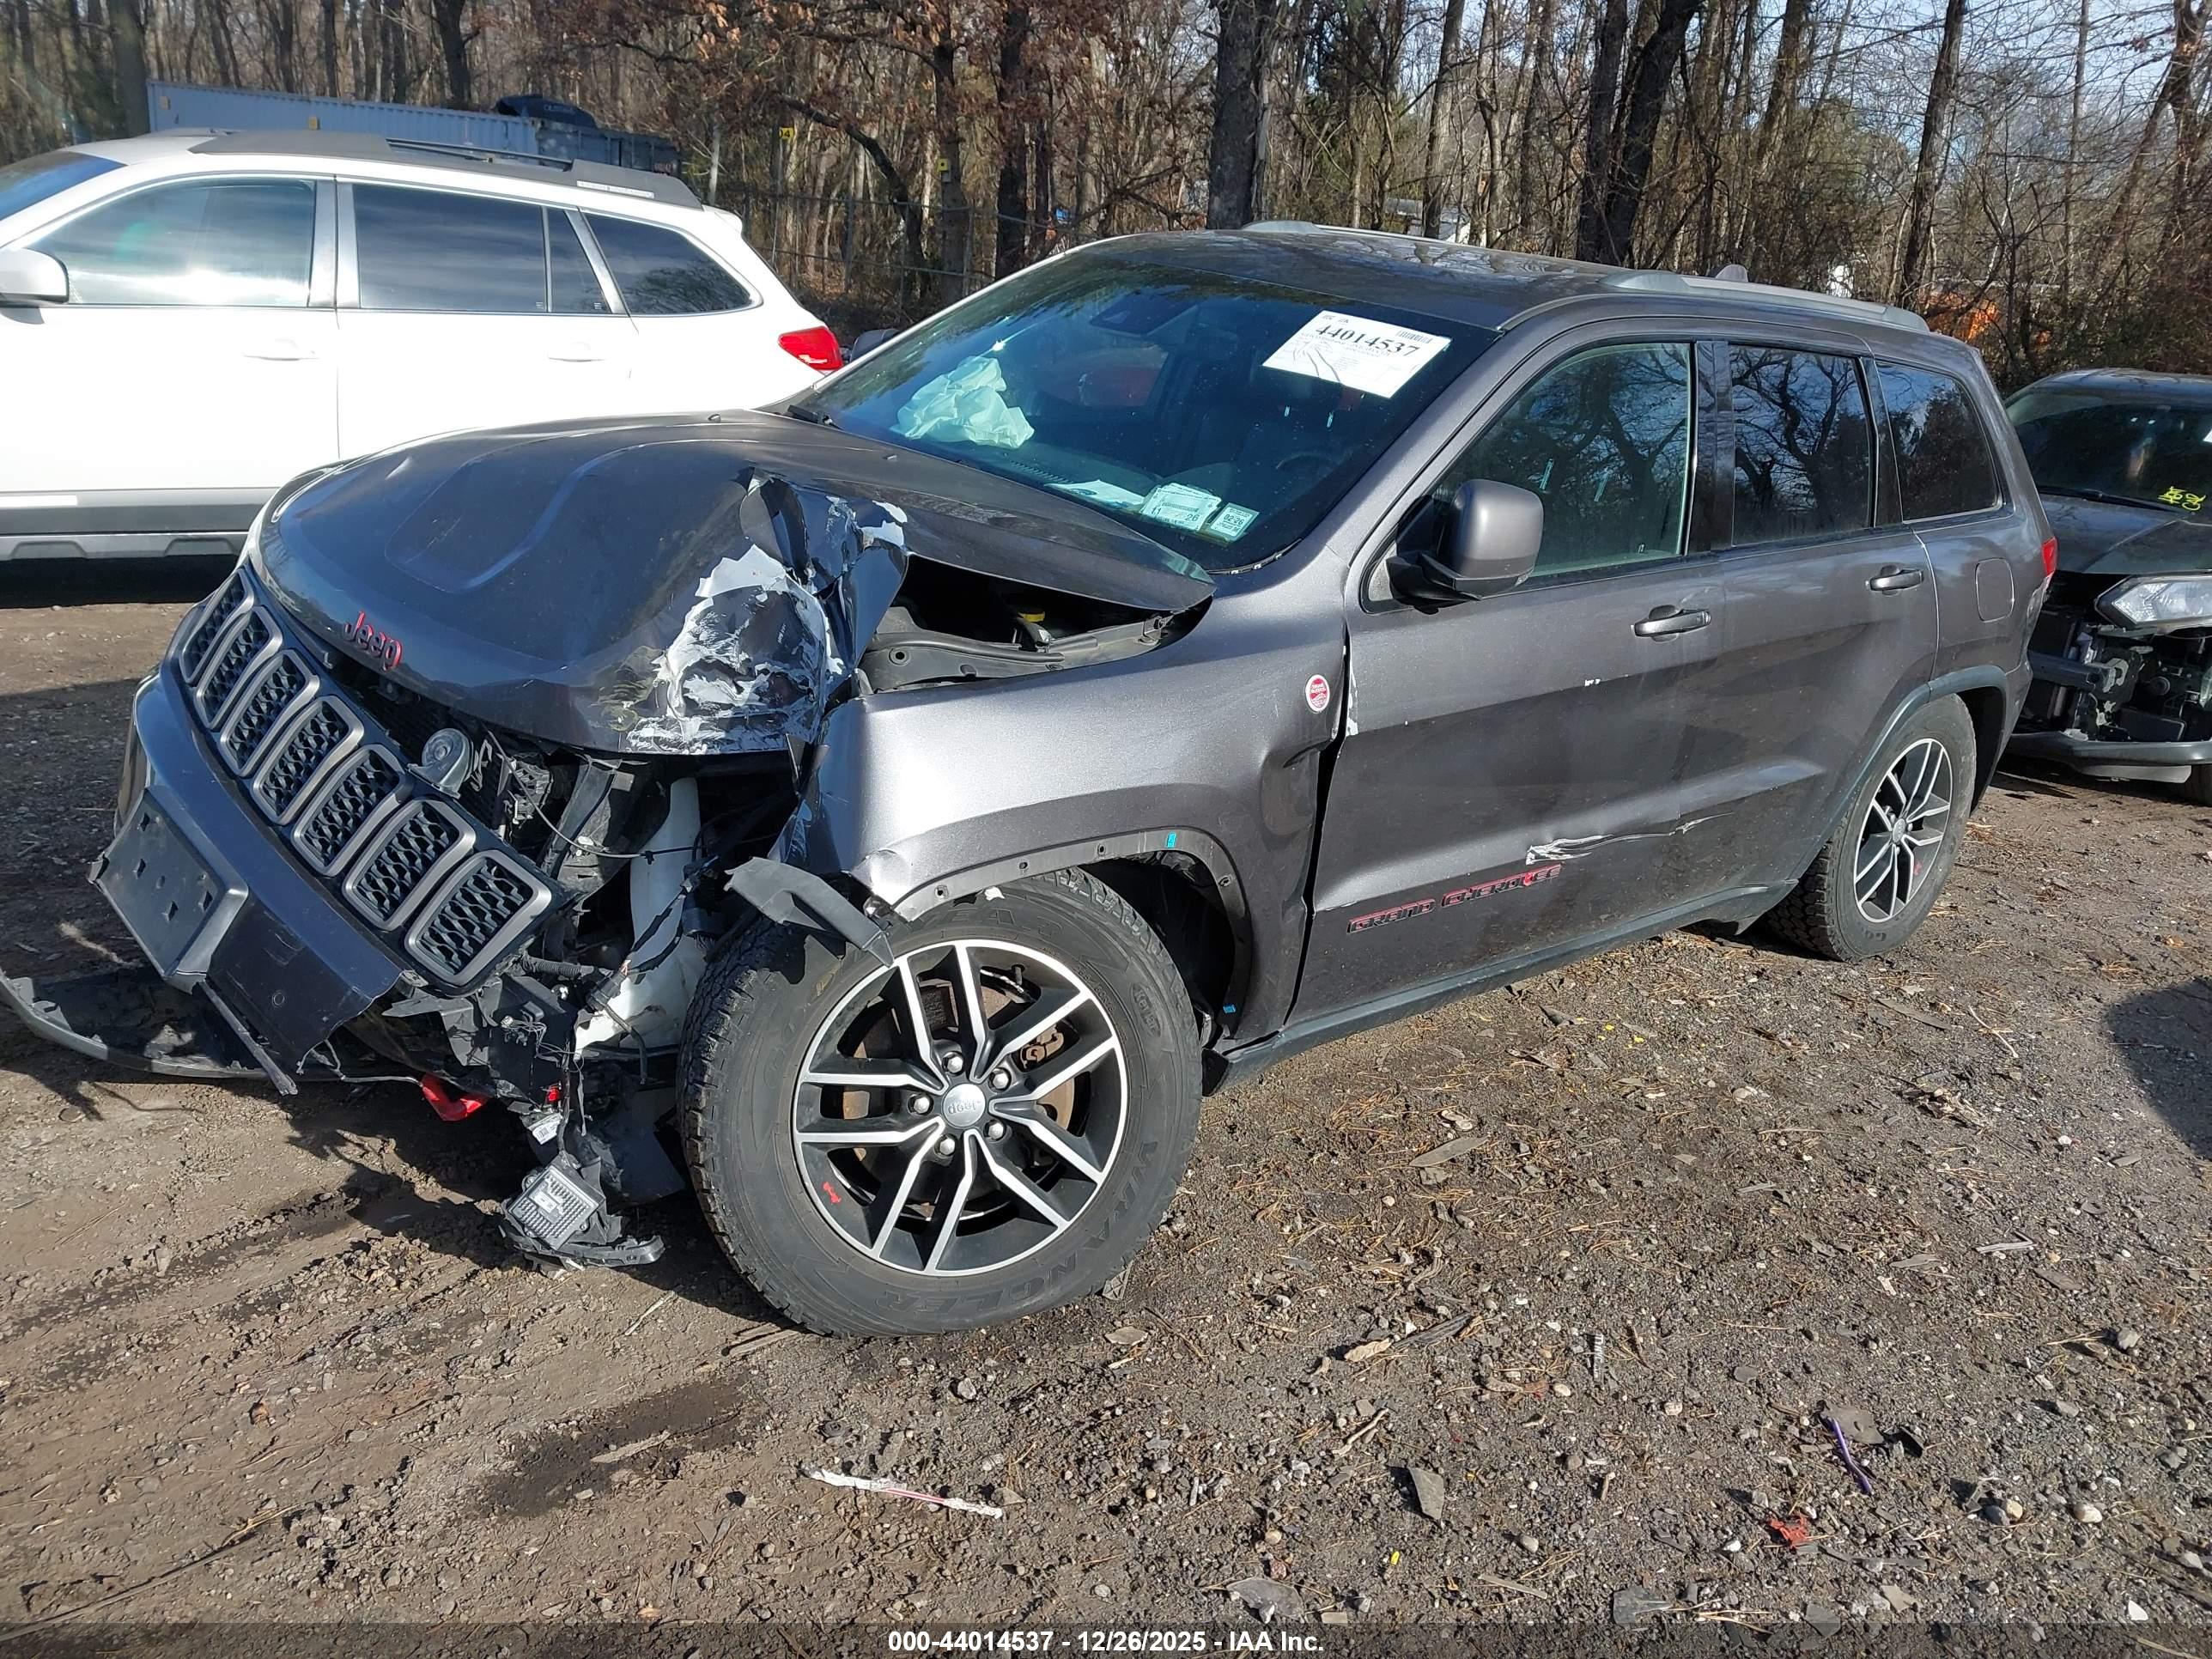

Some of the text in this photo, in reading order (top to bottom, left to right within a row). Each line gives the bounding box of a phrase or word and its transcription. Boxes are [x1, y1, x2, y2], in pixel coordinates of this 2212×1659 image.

[1316, 325, 1420, 356] 44014537
[1185, 513, 1200, 522] 26
[1346, 899, 1436, 933] GRAND
